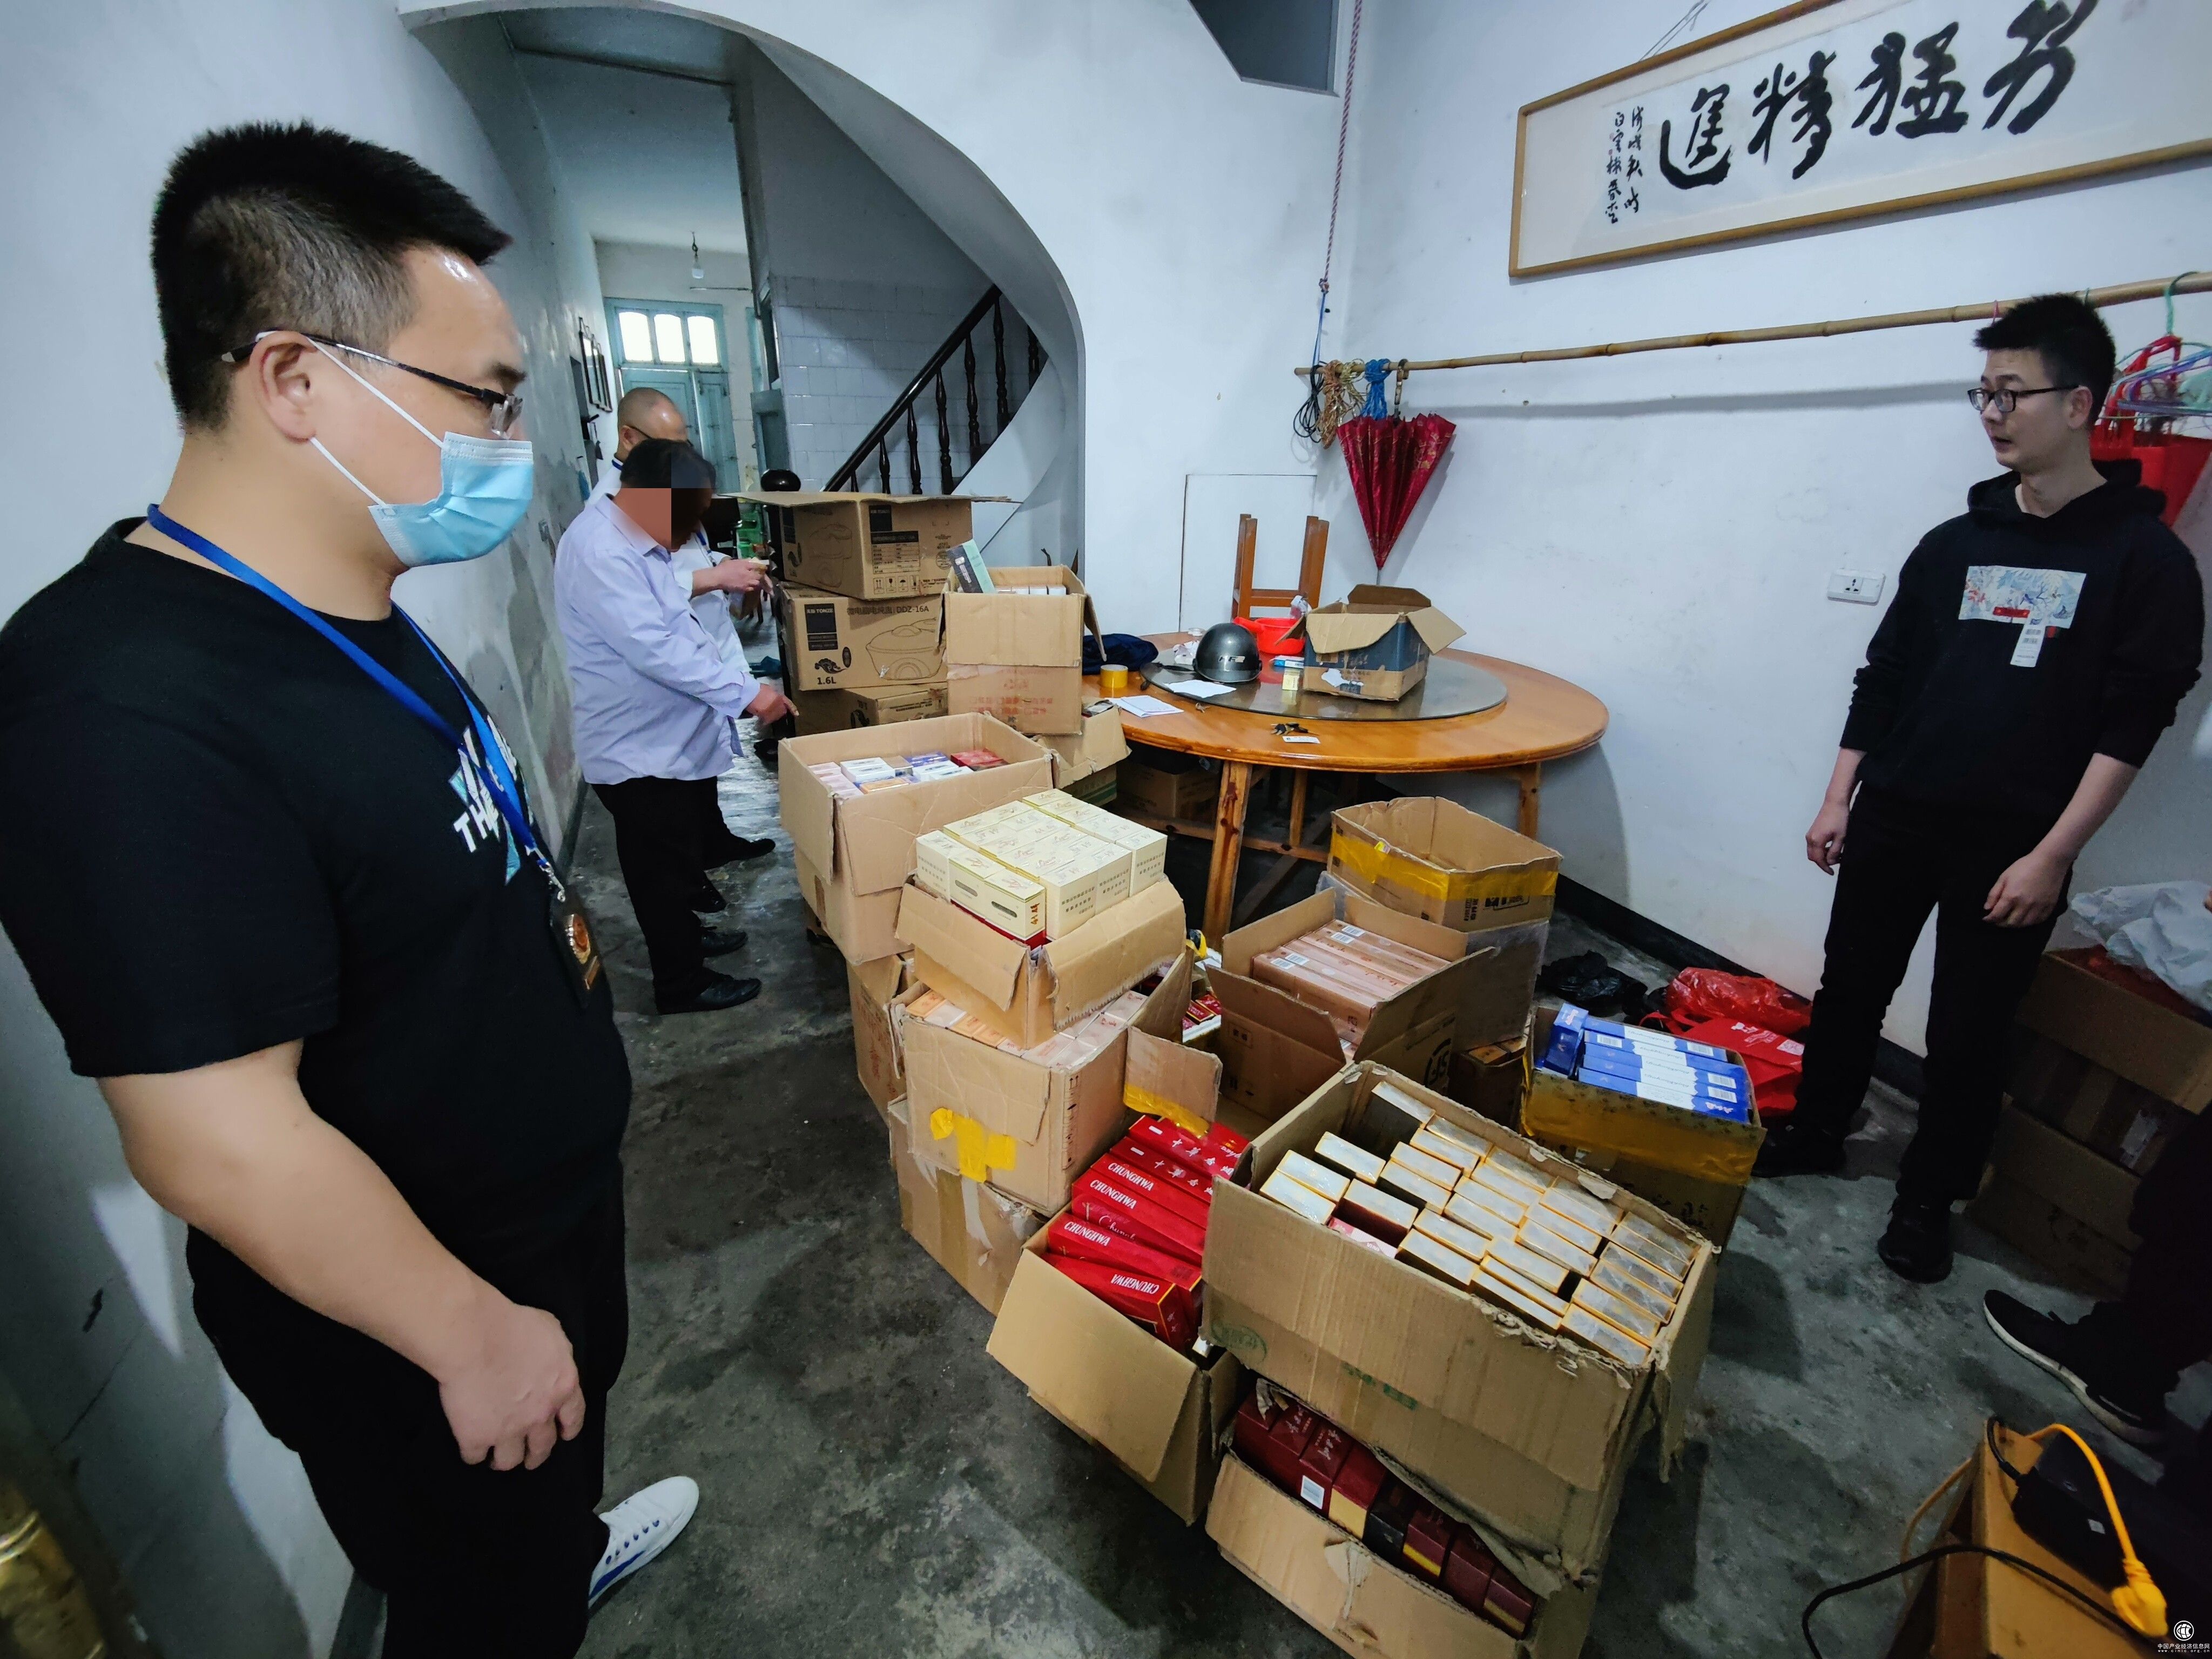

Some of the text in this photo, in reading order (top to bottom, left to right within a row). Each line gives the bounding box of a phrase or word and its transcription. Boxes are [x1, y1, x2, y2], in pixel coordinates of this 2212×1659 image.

[817, 676, 837, 685] 1.6L
[1108, 1162, 1155, 1191] CHUNGHWA
[1089, 1179, 1137, 1210] CHUNGHWA
[1063, 1221, 1111, 1246] CHUNGHWA
[1110, 1273, 1160, 1295] CHUNGHWA
